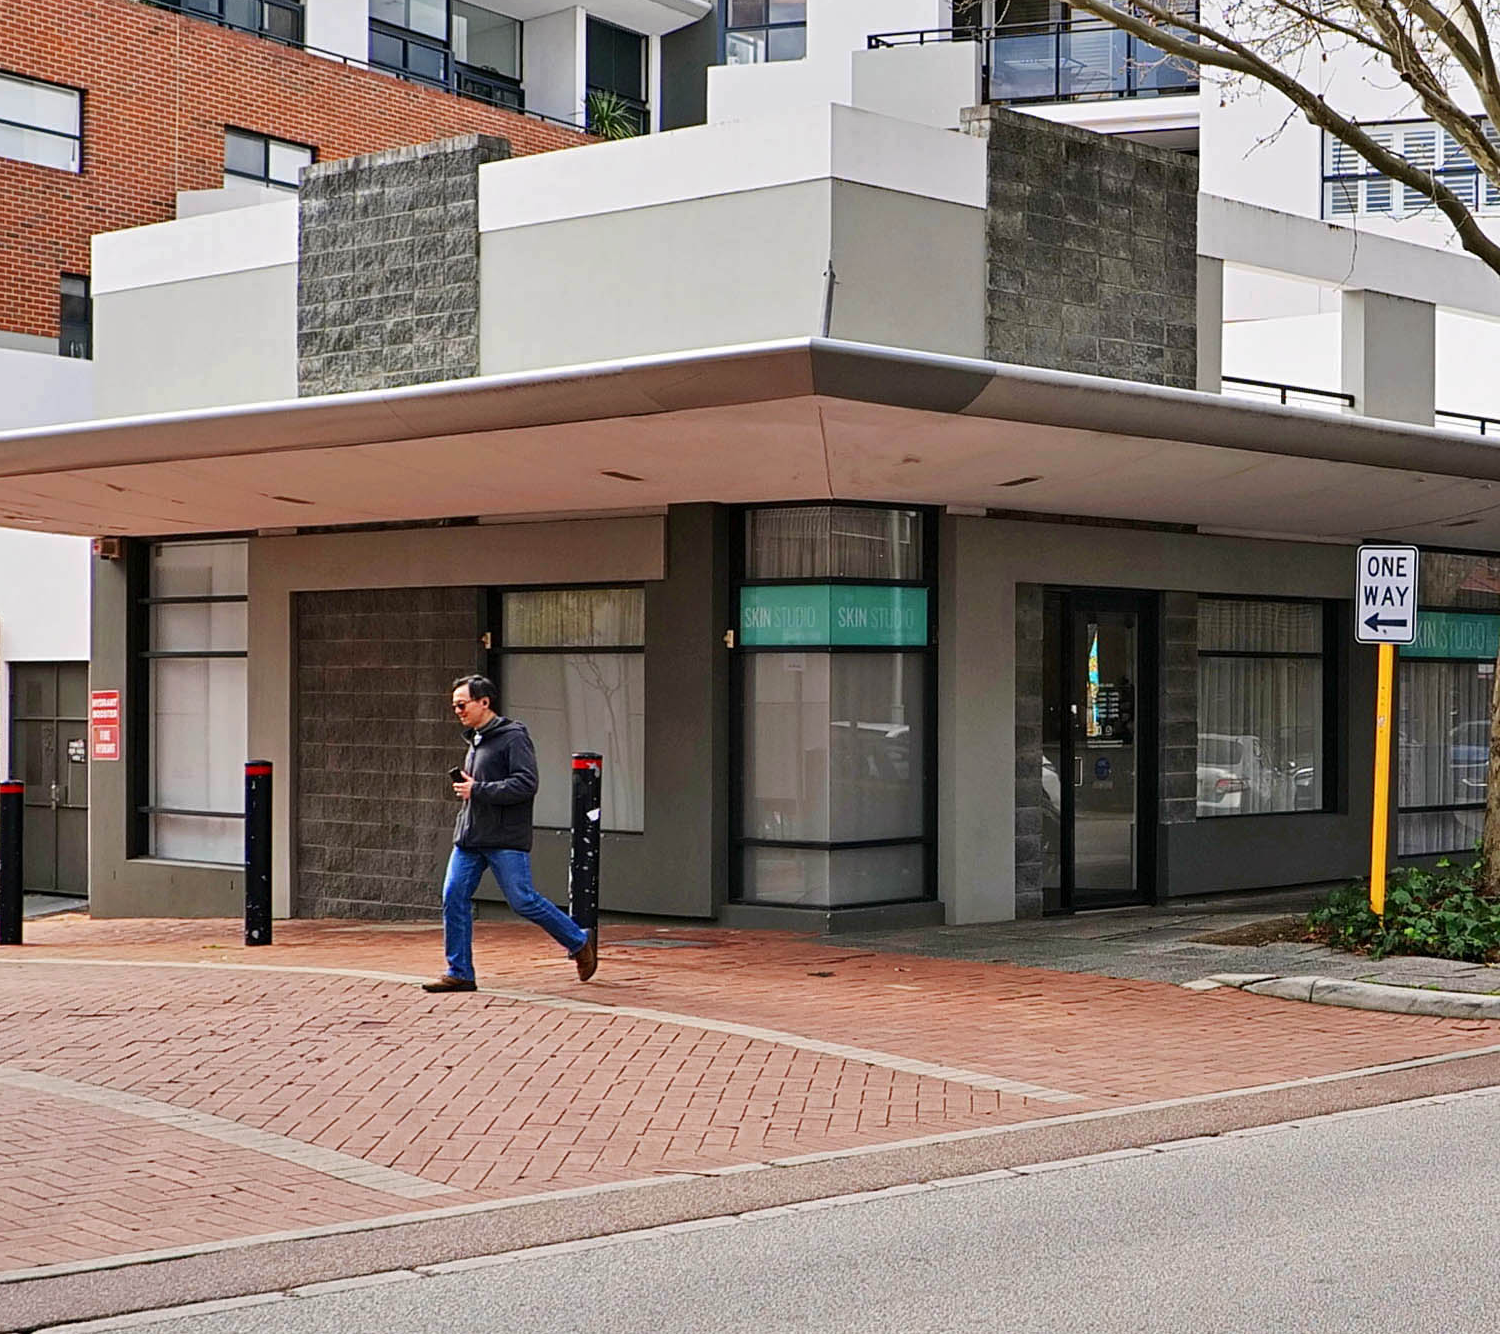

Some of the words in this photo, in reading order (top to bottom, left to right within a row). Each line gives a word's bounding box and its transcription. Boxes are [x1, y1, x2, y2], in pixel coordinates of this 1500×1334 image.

[1368, 556, 1407, 577] ONE
[1364, 585, 1409, 607] WAY
[745, 606, 772, 628] SKIN
[774, 606, 816, 628] STUDIO
[838, 606, 868, 628] SKIN
[871, 607, 915, 629] STUDIO
[1414, 619, 1437, 649] KIN
[1439, 620, 1486, 651] STUDIO
